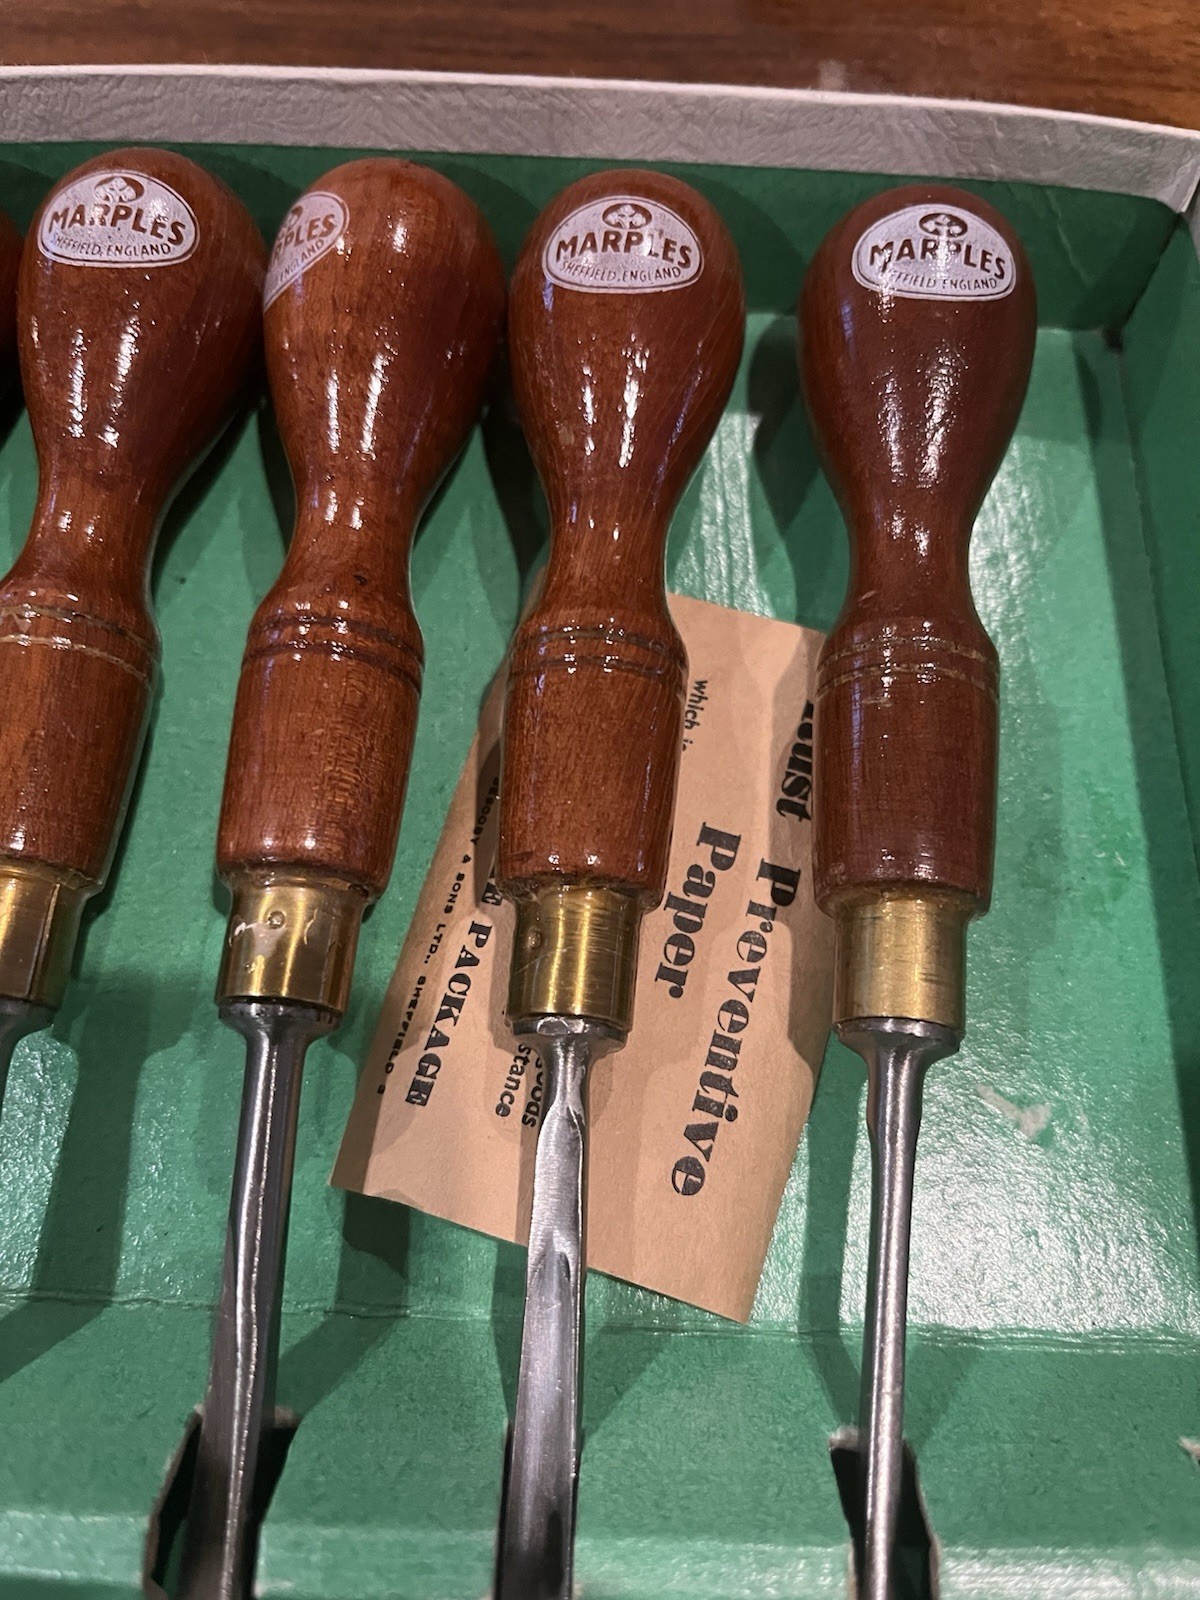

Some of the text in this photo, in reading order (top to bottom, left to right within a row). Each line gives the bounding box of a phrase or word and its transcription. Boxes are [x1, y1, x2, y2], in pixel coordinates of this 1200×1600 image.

[49, 203, 186, 246] MARPLES
[556, 229, 693, 269] MARPLES
[868, 238, 1006, 281] MARPLES
[684, 679, 709, 731] which
[654, 821, 742, 999] Paper
[405, 920, 493, 1107] PACKAGE
[672, 857, 801, 1196] Preventive
